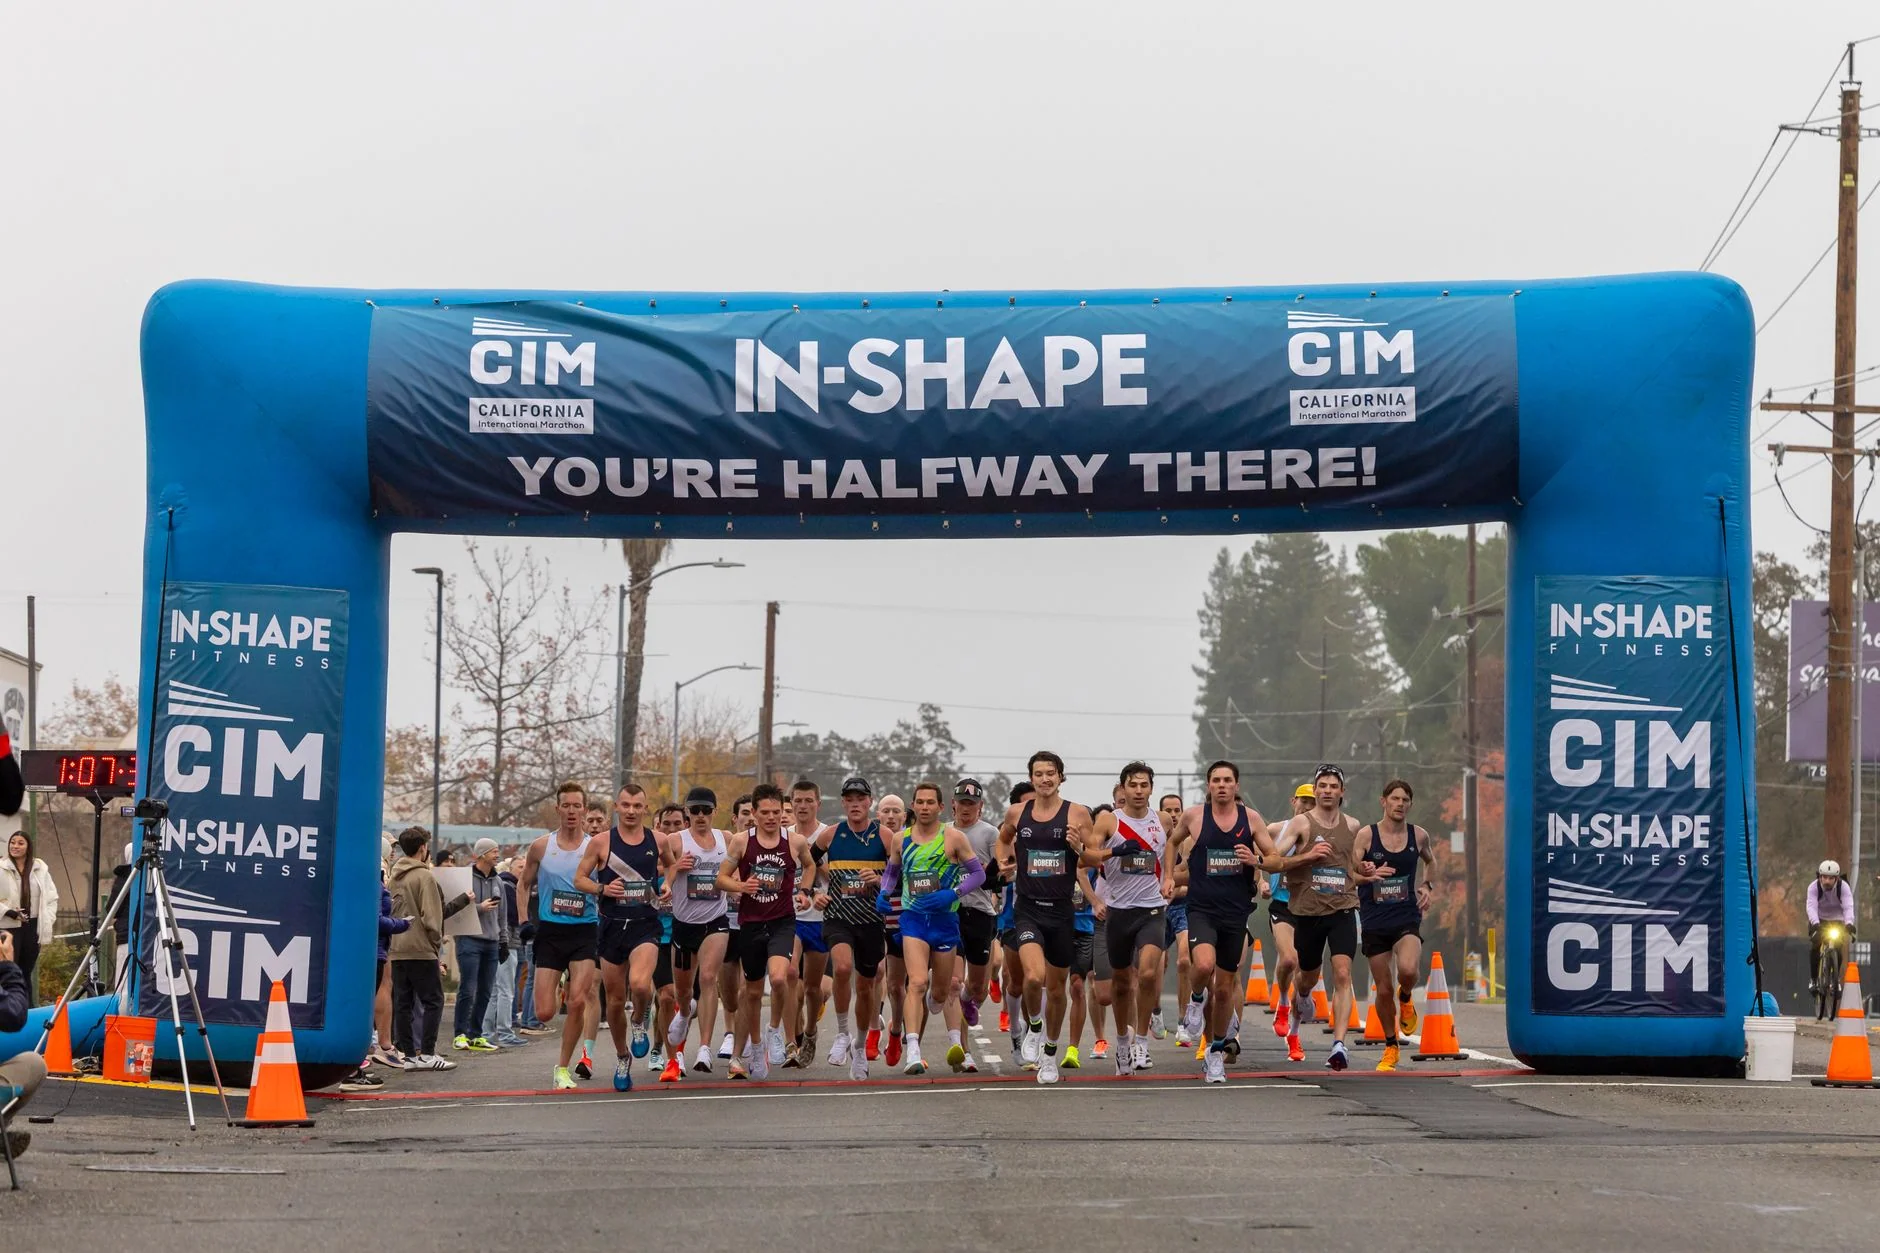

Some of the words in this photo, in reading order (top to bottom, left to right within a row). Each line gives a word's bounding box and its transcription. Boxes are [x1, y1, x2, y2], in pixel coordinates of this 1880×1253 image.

[469, 339, 596, 387] CIM
[1287, 329, 1415, 376] CIM
[735, 333, 1148, 414] IN-SHAPE
[478, 404, 584, 418] CALIFORNIA
[1299, 393, 1407, 409] CALIFORNIA
[478, 421, 538, 429] International
[540, 421, 585, 429] Marathon
[1299, 411, 1360, 420] International
[1361, 410, 1407, 418] Marathon
[782, 453, 1109, 500] HALFWAY
[1128, 446, 1378, 493] THERE!
[170, 609, 332, 652] IN-SHAPE
[1550, 603, 1713, 639] IN-SHAPE
[169, 649, 329, 670] FITNESS
[1550, 643, 1712, 657] FITNESS
[164, 724, 324, 801] CIM
[1550, 718, 1712, 789] CIM
[1547, 812, 1711, 849] IN-SHAPE
[756, 854, 786, 868] ALMIGHTY
[1033, 858, 1060, 867] ROBERTS
[1547, 852, 1710, 866] FITNESS
[757, 872, 775, 882] 466
[847, 880, 866, 889] 367
[913, 879, 931, 888] PACER
[153, 927, 312, 1005] CIM
[1547, 922, 1709, 993] CIM
